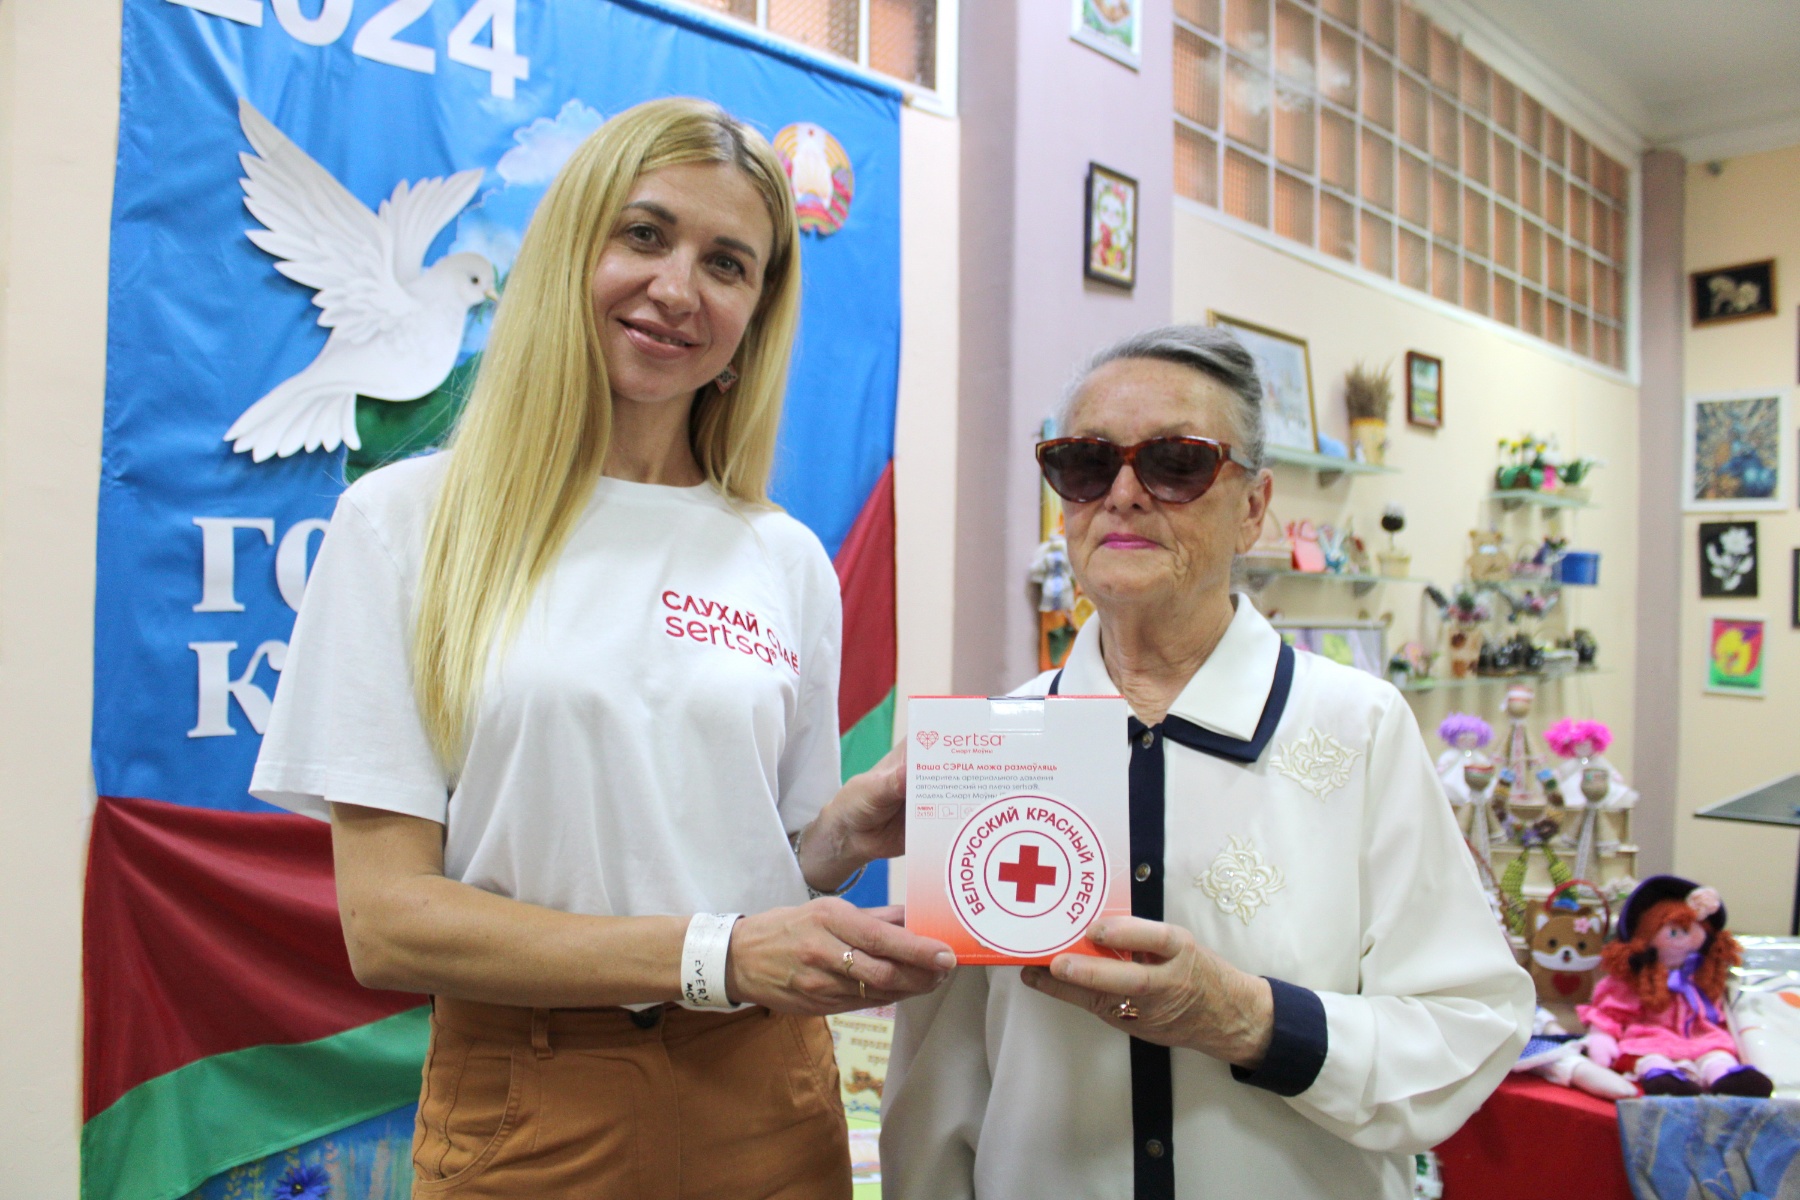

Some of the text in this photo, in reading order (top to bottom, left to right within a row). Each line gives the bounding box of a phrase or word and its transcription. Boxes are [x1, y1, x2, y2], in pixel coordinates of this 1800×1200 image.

[662, 590, 760, 637] СЛУХАЙ
[916, 763, 941, 771] Ваша
[943, 763, 974, 772] СЭРЦА
[1004, 762, 1057, 773] размаўляць
[915, 774, 1054, 783] Измеритель артериального давления
[915, 792, 944, 800] модель
[945, 791, 971, 801] Смарт
[960, 806, 1095, 925] БЕЛОРУССКИЙ КРАСНЫЙ КРЕСТ
